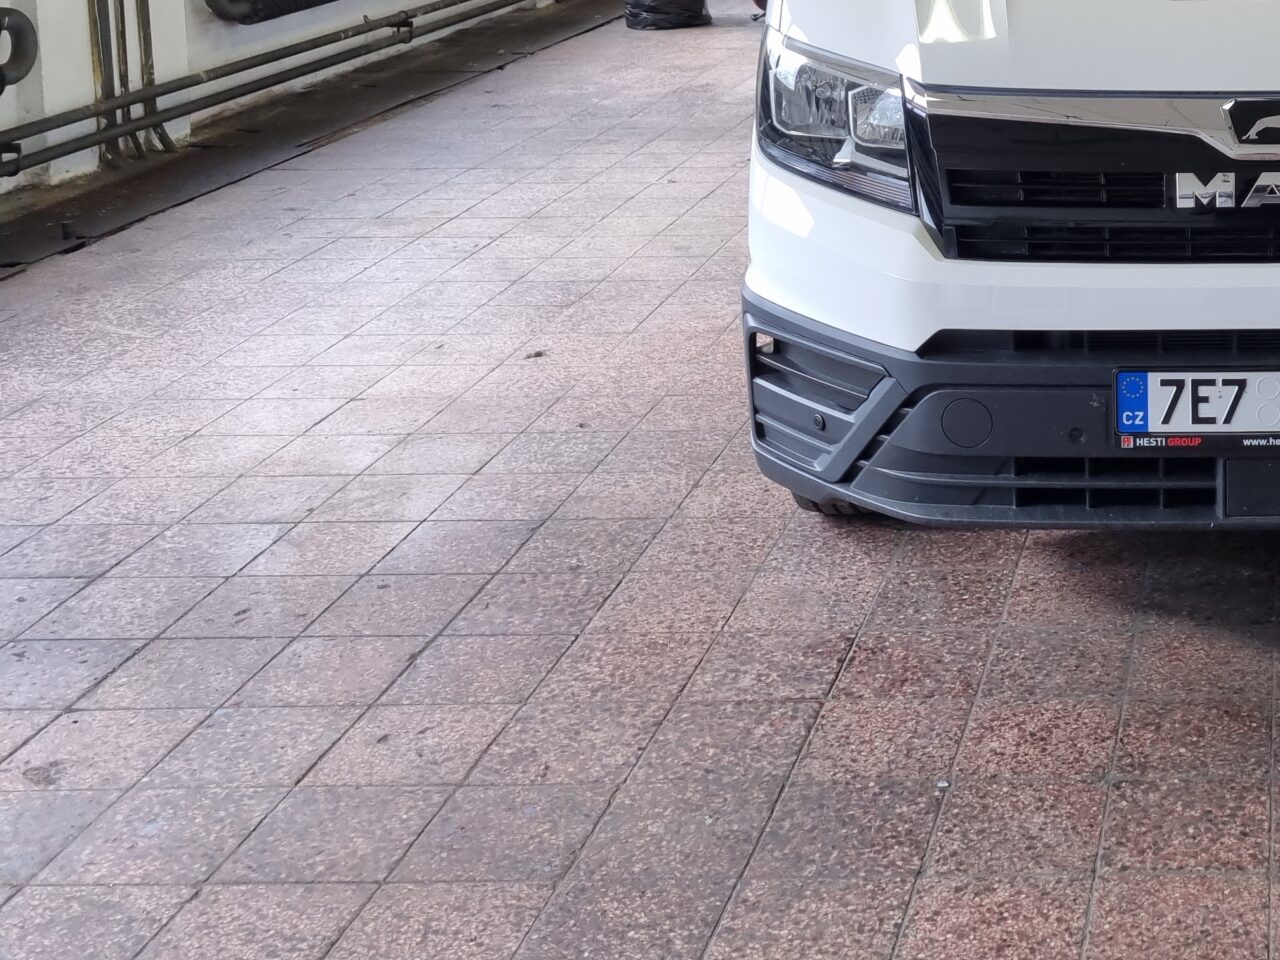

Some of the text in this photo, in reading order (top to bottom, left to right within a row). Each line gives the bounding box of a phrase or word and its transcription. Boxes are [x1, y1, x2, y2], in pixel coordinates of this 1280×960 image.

[1159, 378, 1247, 425] 7E7
[1122, 411, 1144, 425] CZ
[1136, 437, 1202, 446] HESTI GROUP
